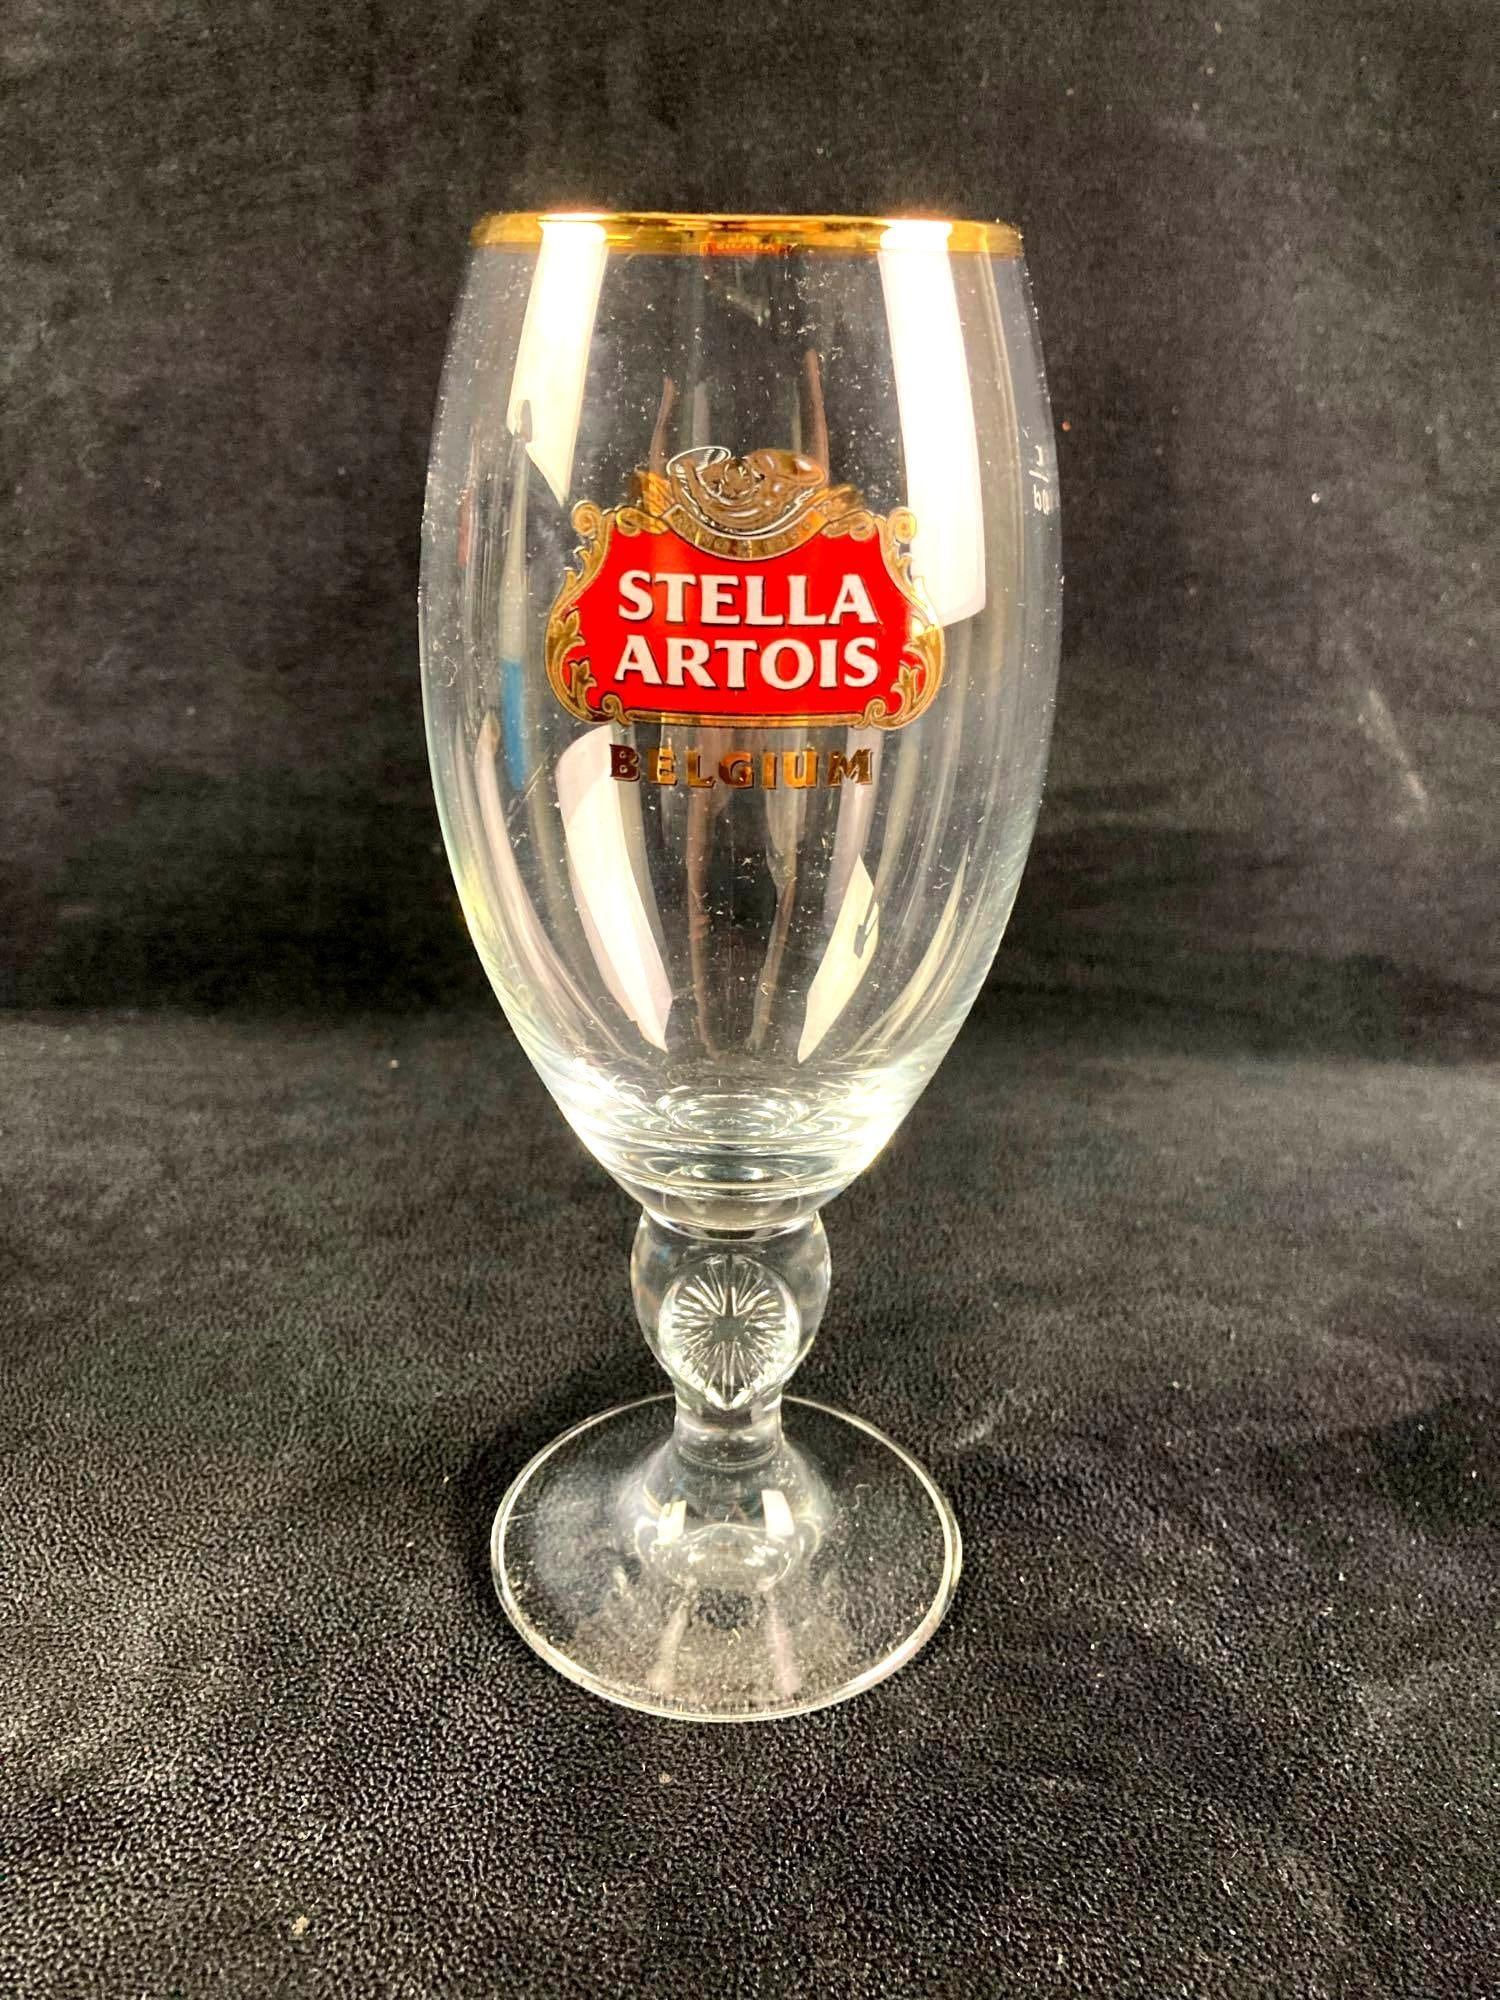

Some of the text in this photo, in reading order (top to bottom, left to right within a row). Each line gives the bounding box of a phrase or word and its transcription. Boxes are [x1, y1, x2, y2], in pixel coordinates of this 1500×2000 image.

[617, 569, 879, 626] STELLA
[613, 634, 880, 690] ARTOIS
[609, 743, 875, 790] BELGIUM
